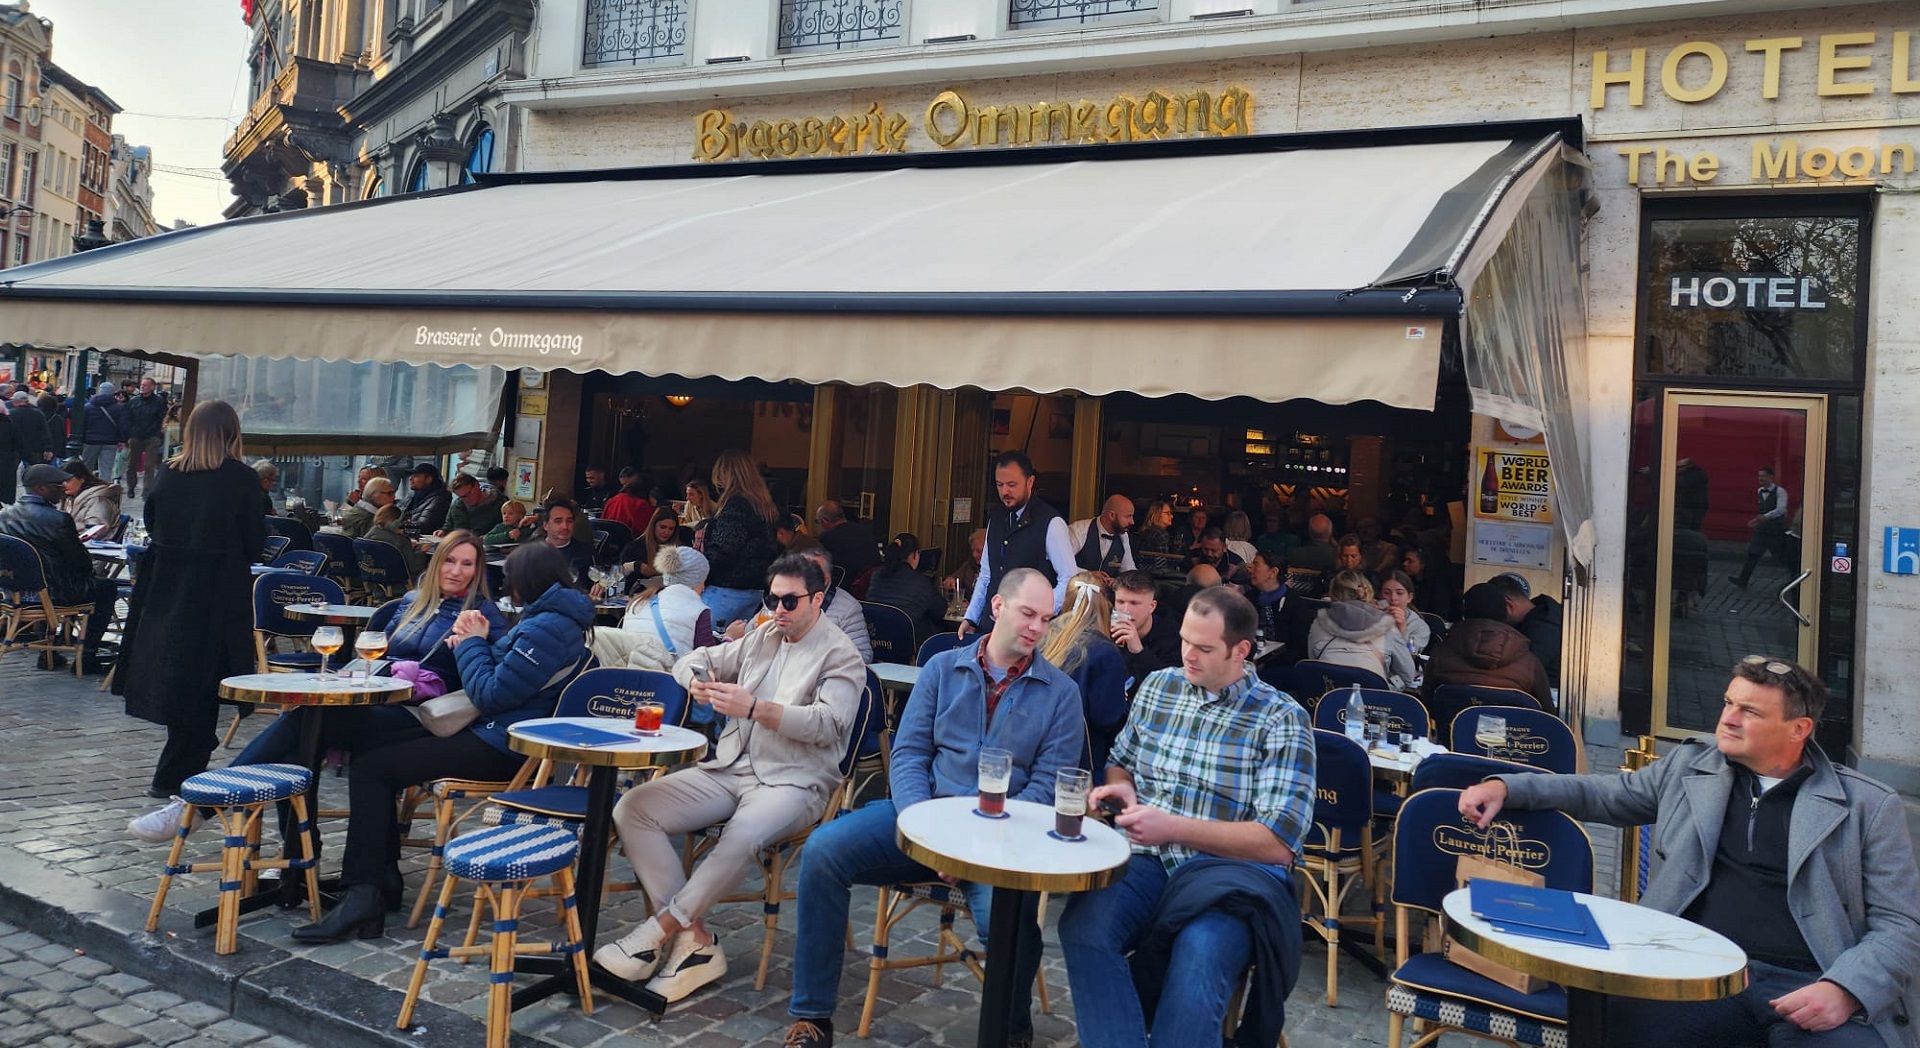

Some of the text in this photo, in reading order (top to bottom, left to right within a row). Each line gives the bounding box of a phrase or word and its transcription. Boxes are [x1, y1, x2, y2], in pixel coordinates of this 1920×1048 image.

[1590, 31, 1920, 109] HOTEL
[691, 84, 1249, 161] Brasserie Ommegang
[1618, 139, 1915, 184] The Moon
[1670, 277, 1826, 309] HOTEL
[414, 325, 583, 356] Brasserie Ommegang
[1501, 456, 1550, 469] WORLD
[1501, 467, 1549, 483] BEER
[1500, 481, 1549, 493] AWARDS
[1500, 501, 1547, 513] WORLD'S
[1512, 509, 1536, 518] BEST
[614, 687, 656, 698] CHAMPAGNE
[592, 700, 637, 716] Laurent-
[1439, 831, 1545, 861] Laurent-Perrier
